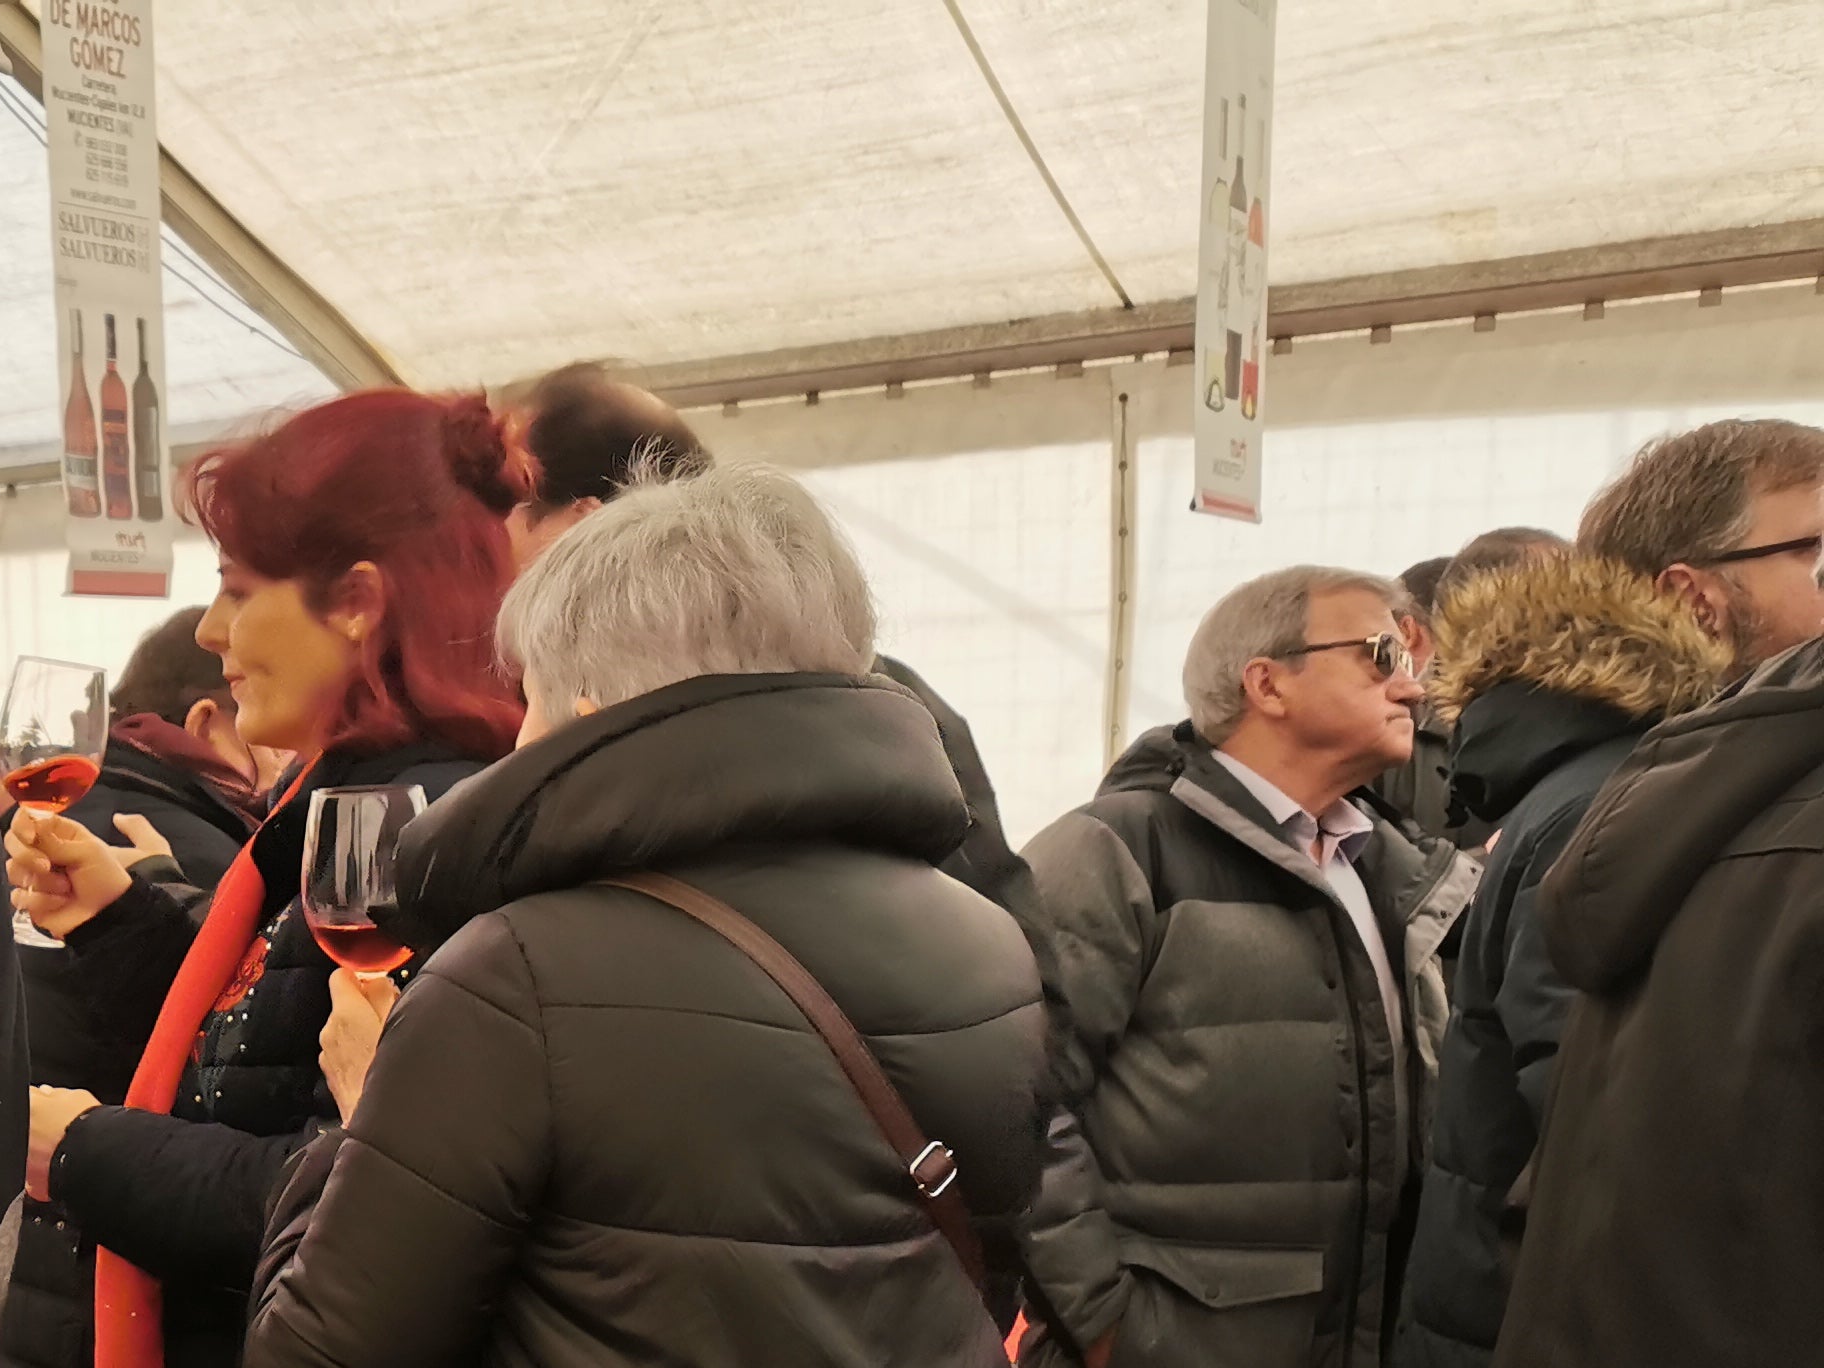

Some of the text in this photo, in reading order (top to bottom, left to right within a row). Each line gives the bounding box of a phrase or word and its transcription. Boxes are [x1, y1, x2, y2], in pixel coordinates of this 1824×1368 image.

[50, 0, 142, 47] DE MARCOS
[58, 211, 136, 243] SALVUEROS
[60, 237, 137, 268] SALVUEROS
